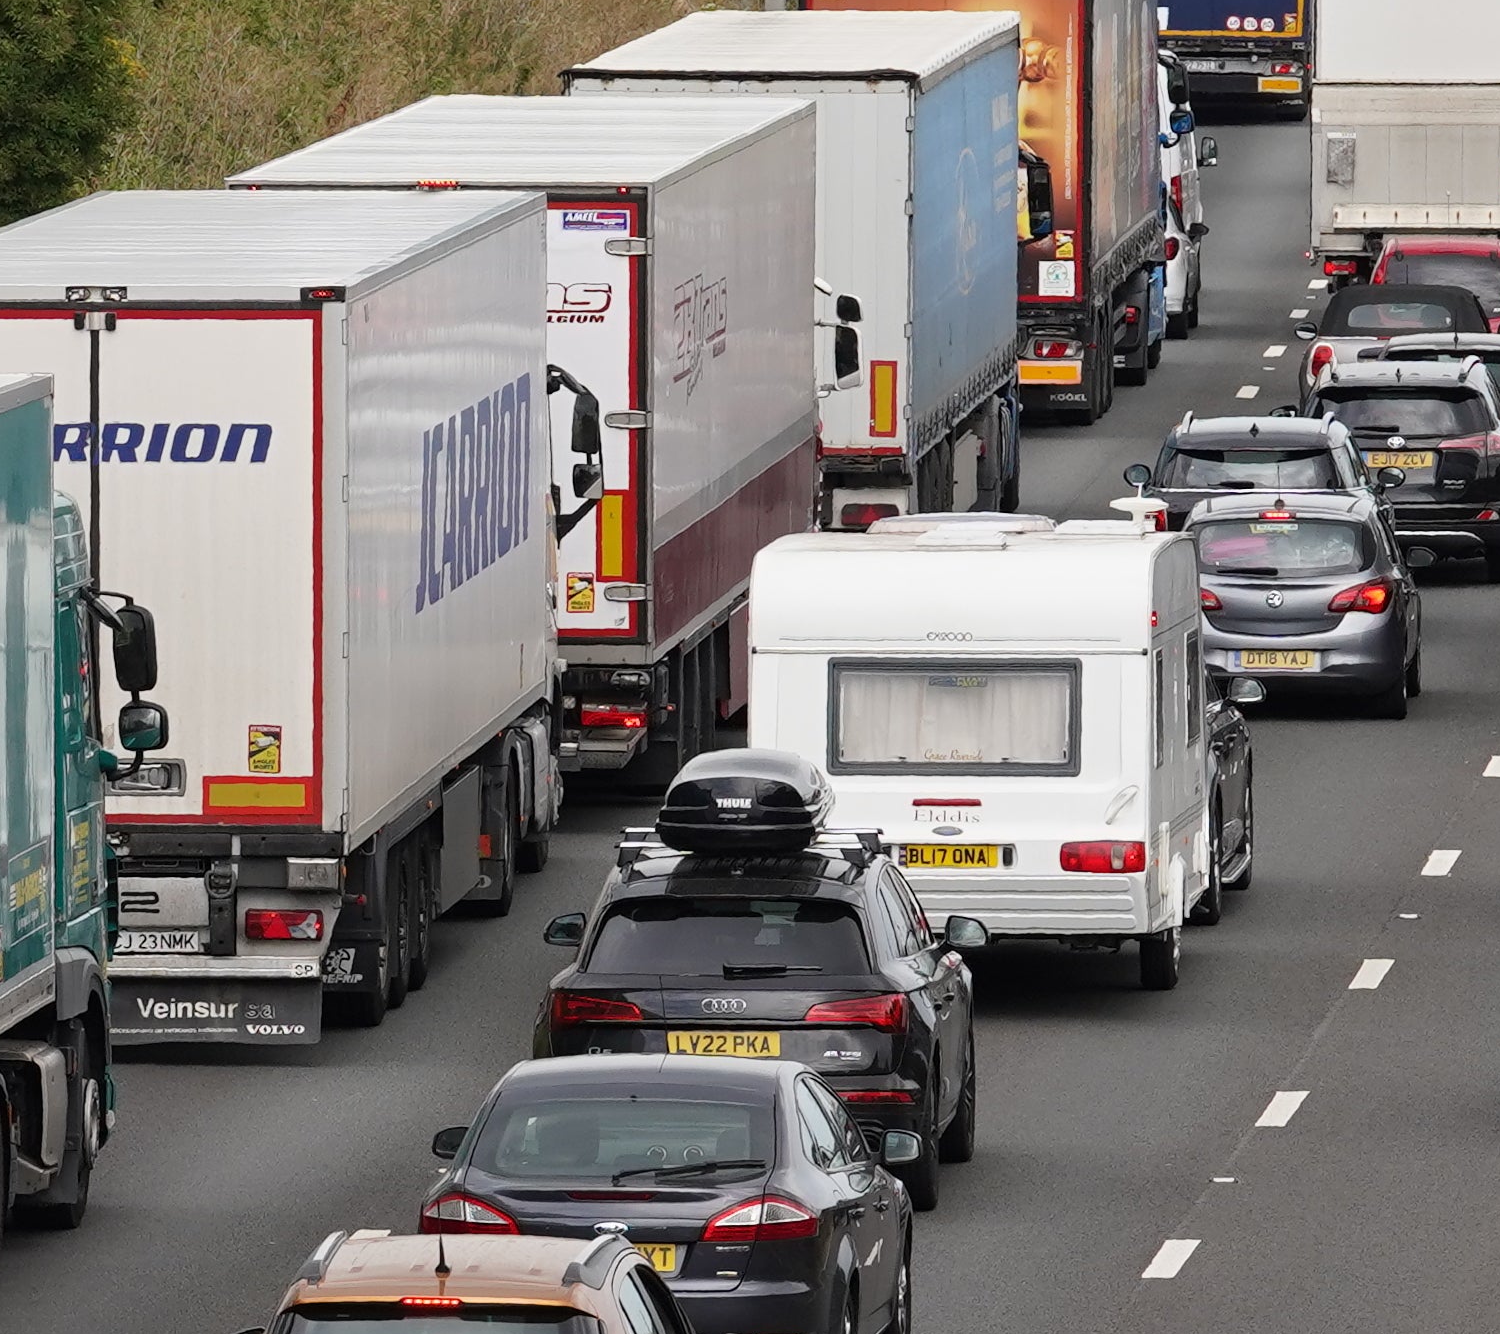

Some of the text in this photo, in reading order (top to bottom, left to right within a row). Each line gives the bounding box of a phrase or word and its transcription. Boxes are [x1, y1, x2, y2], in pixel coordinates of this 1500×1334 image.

[415, 372, 531, 615] JCARRION
[1246, 652, 1309, 666] DT18 YAJ
[924, 749, 947, 760] Grace
[716, 798, 751, 808] THULE
[914, 809, 980, 823] Elddis
[908, 849, 947, 865] BL17
[136, 997, 239, 1019] Veinsur
[246, 1024, 305, 1035] VOLVO
[676, 1034, 772, 1054] LV22 PKA
